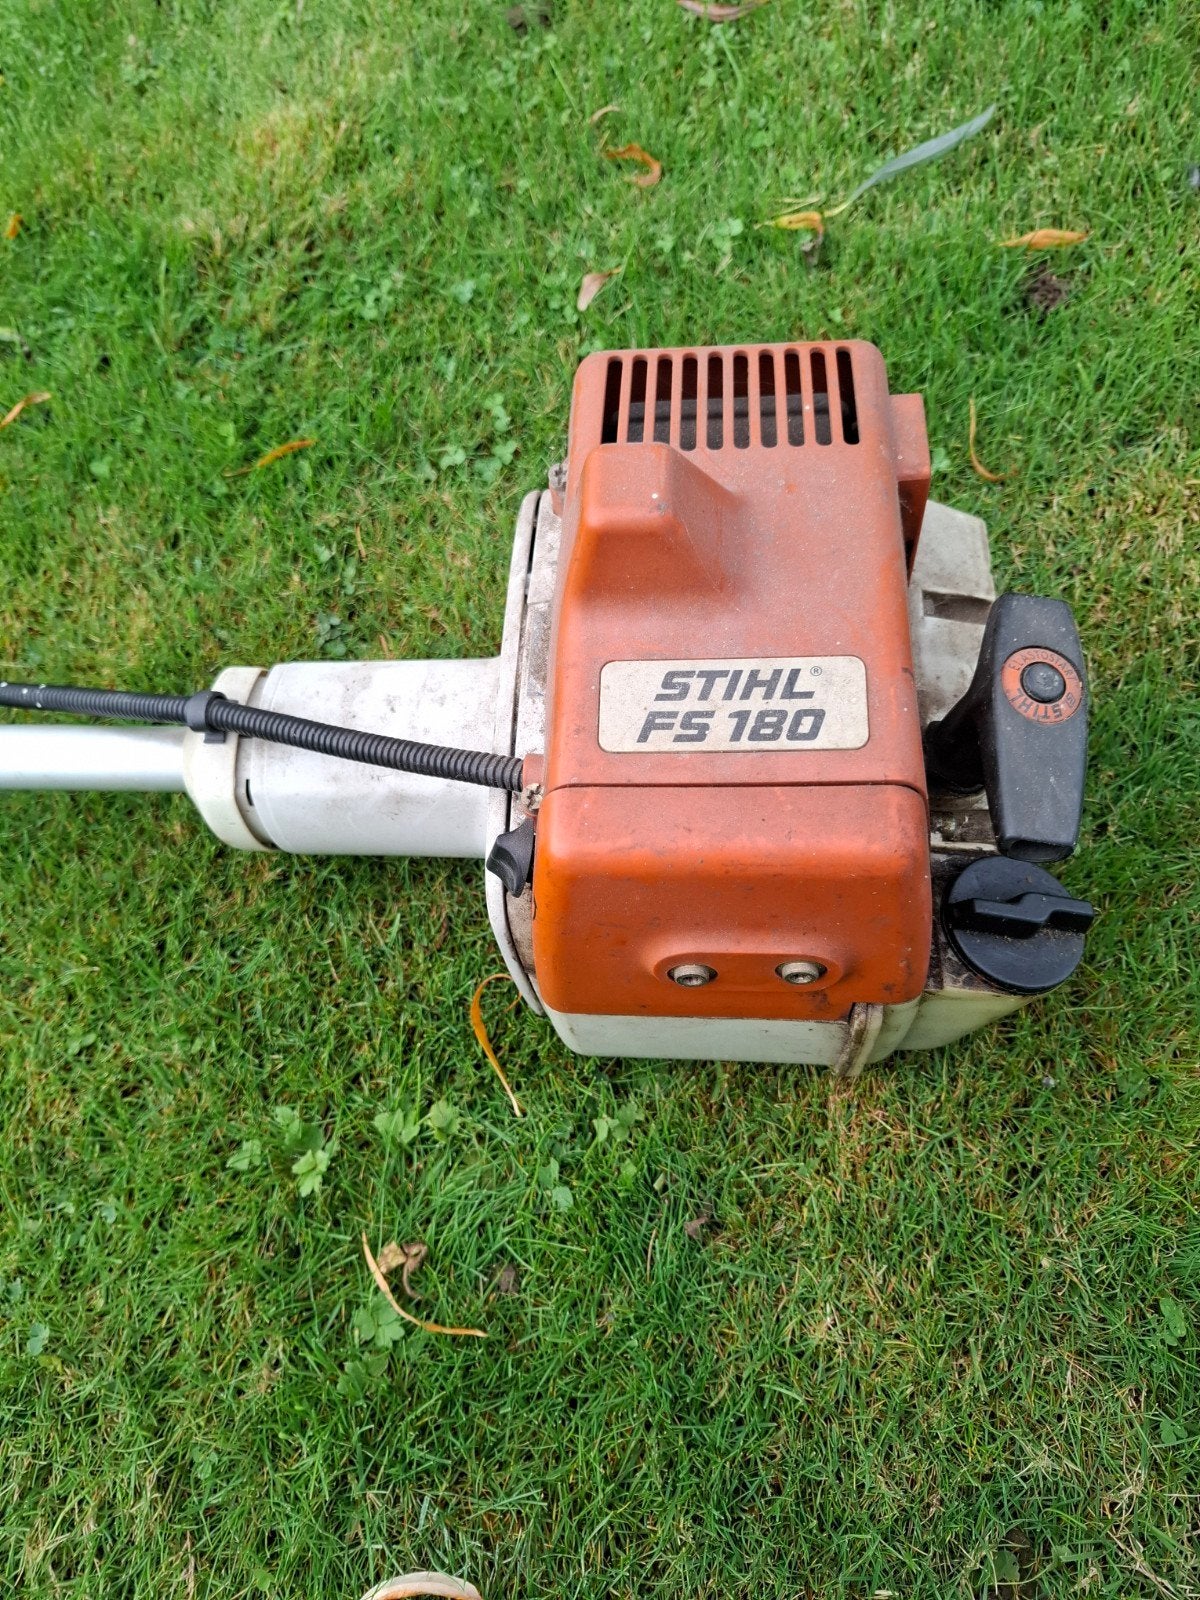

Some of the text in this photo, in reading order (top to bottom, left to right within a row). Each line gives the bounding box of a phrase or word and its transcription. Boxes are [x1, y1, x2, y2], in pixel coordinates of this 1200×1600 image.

[653, 668, 816, 702] STIHL
[1005, 687, 1063, 719] STIHL
[636, 708, 826, 744] FS 180
